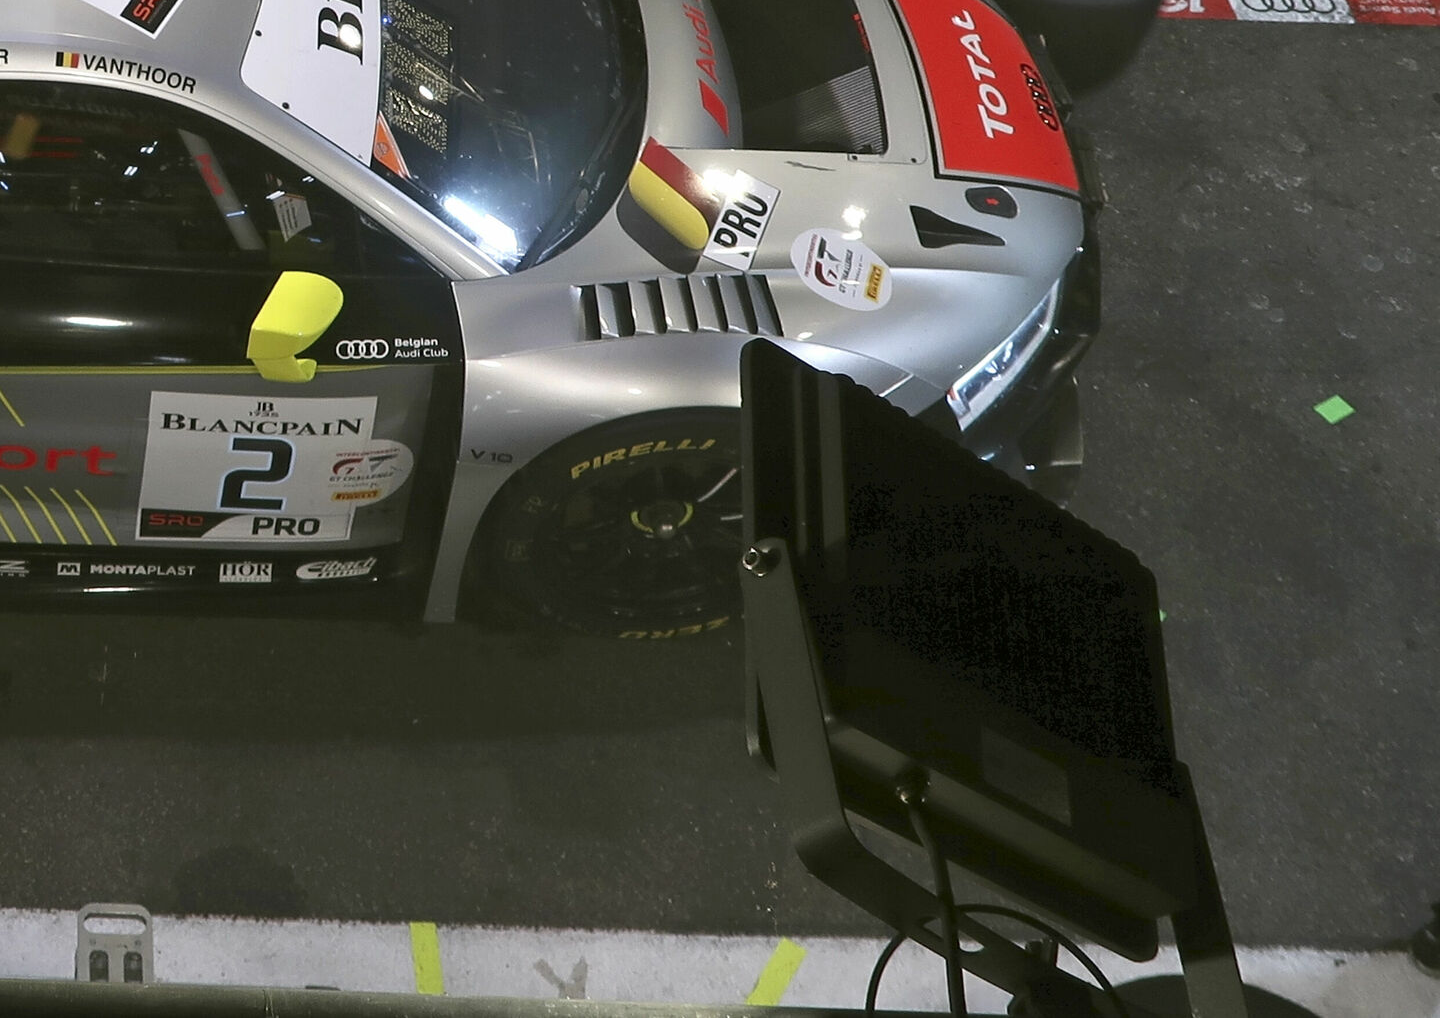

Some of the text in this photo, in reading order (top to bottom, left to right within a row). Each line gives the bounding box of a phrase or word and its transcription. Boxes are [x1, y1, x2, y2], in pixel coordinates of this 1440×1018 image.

[682, 2, 721, 85] Audi
[83, 54, 197, 94] VANTHOOR
[950, 9, 1015, 139] TOTAL
[394, 337, 438, 349] Belgian
[394, 348, 449, 359] Audi Club
[160, 412, 364, 436] BLANCPAIN
[570, 439, 716, 480] PIRELLI
[219, 437, 294, 511] 2
[148, 513, 204, 527] SRO
[251, 516, 321, 536] PRO
[89, 563, 196, 576] MONTAPLAST
[222, 560, 271, 576] HÖR
